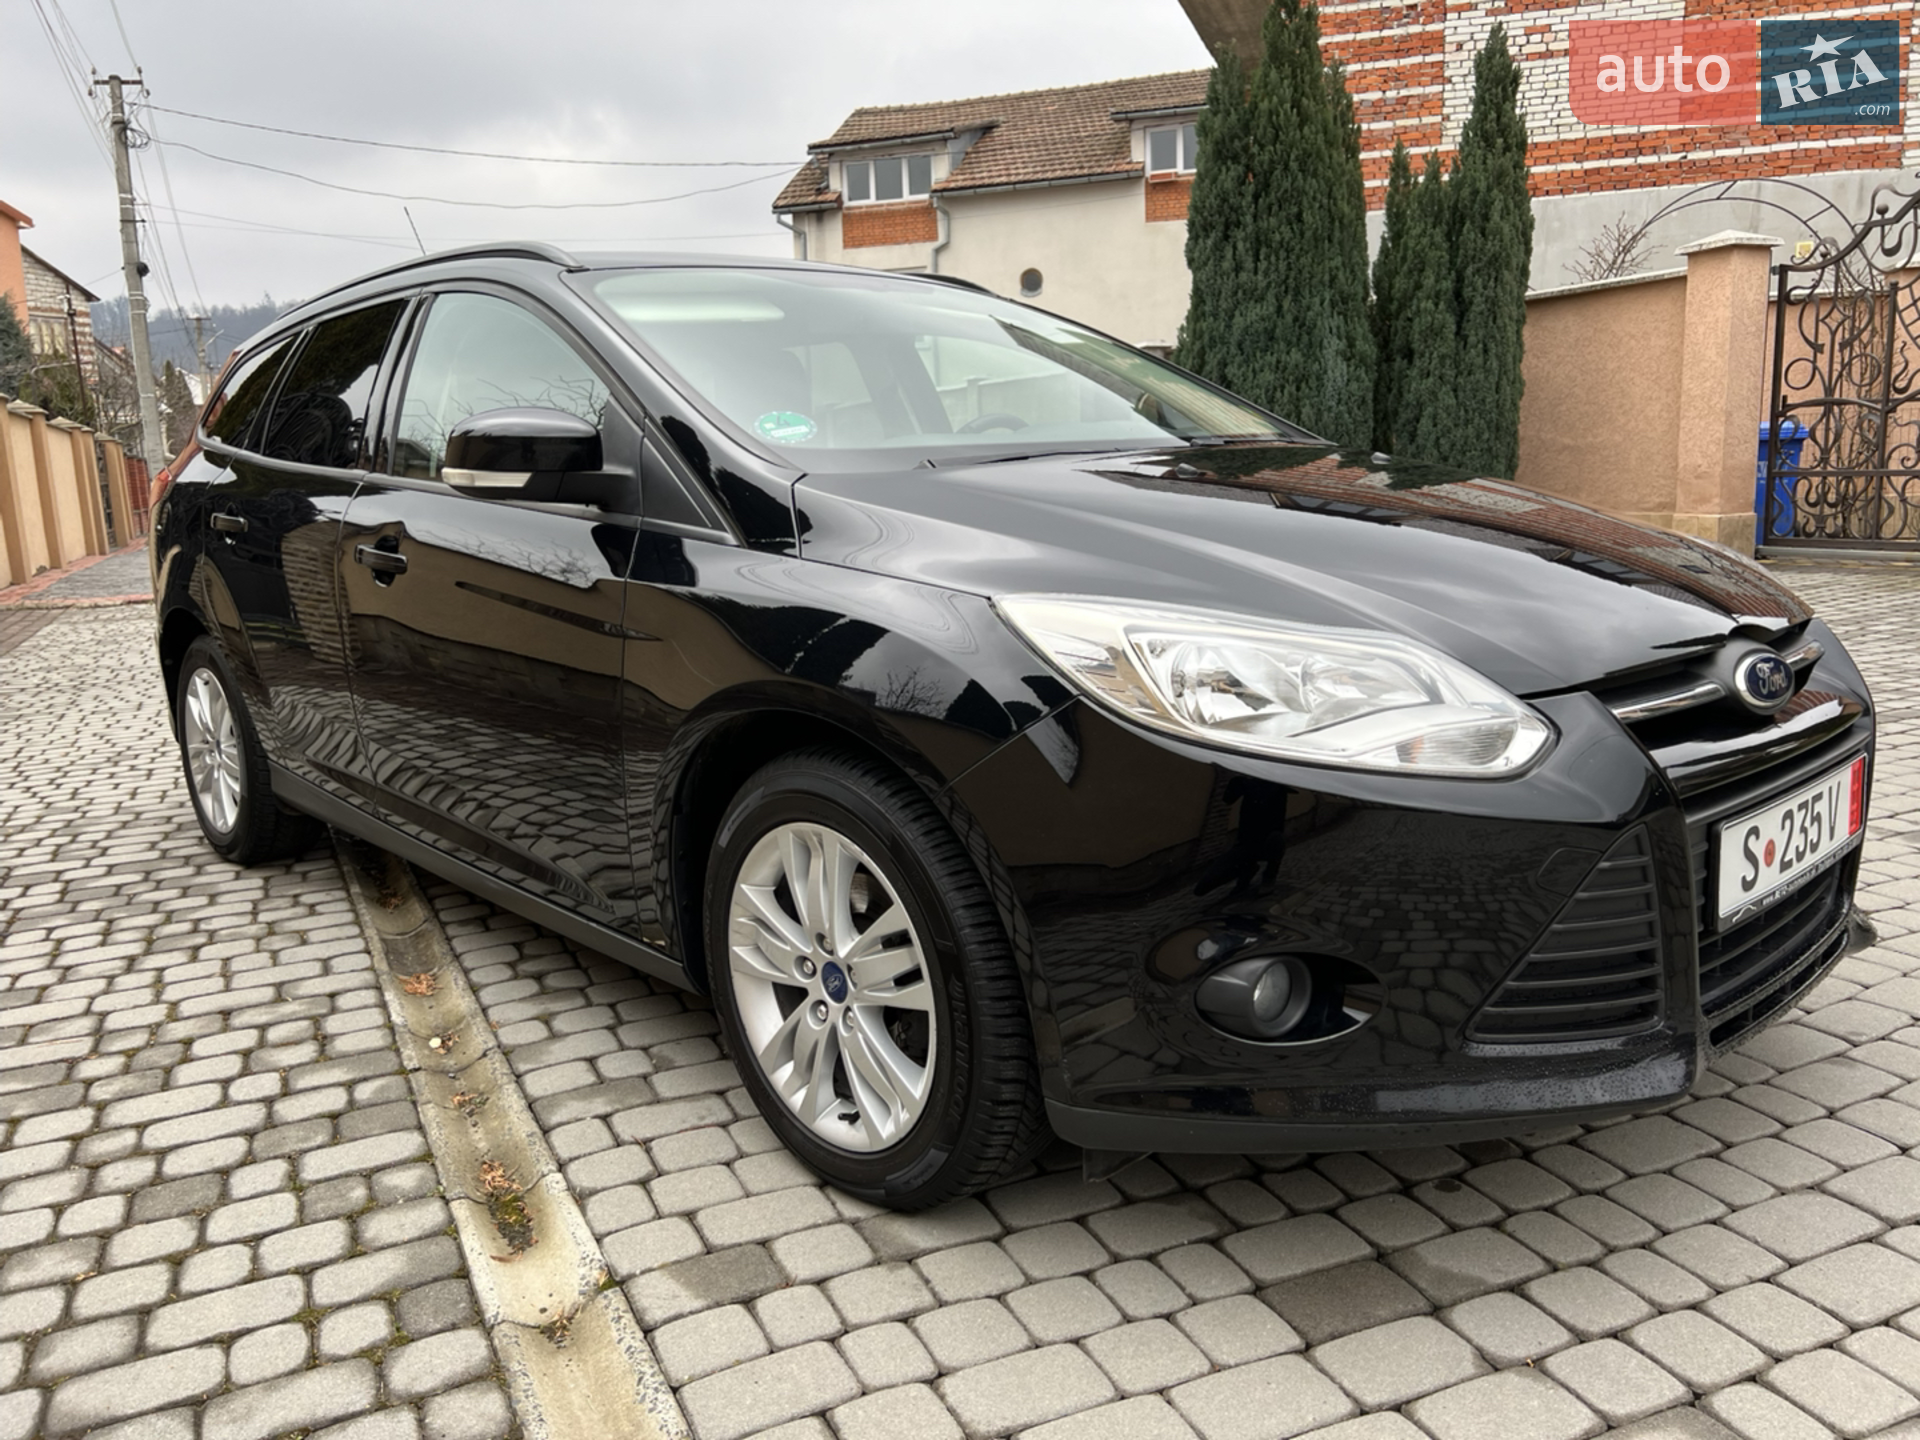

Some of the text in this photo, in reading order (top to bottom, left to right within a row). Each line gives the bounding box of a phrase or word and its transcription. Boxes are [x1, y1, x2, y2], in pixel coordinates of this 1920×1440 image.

[1756, 661, 1788, 695] Ford
[1741, 825, 1760, 892] S
[1779, 791, 1823, 875] 235
[1828, 780, 1841, 842] V
